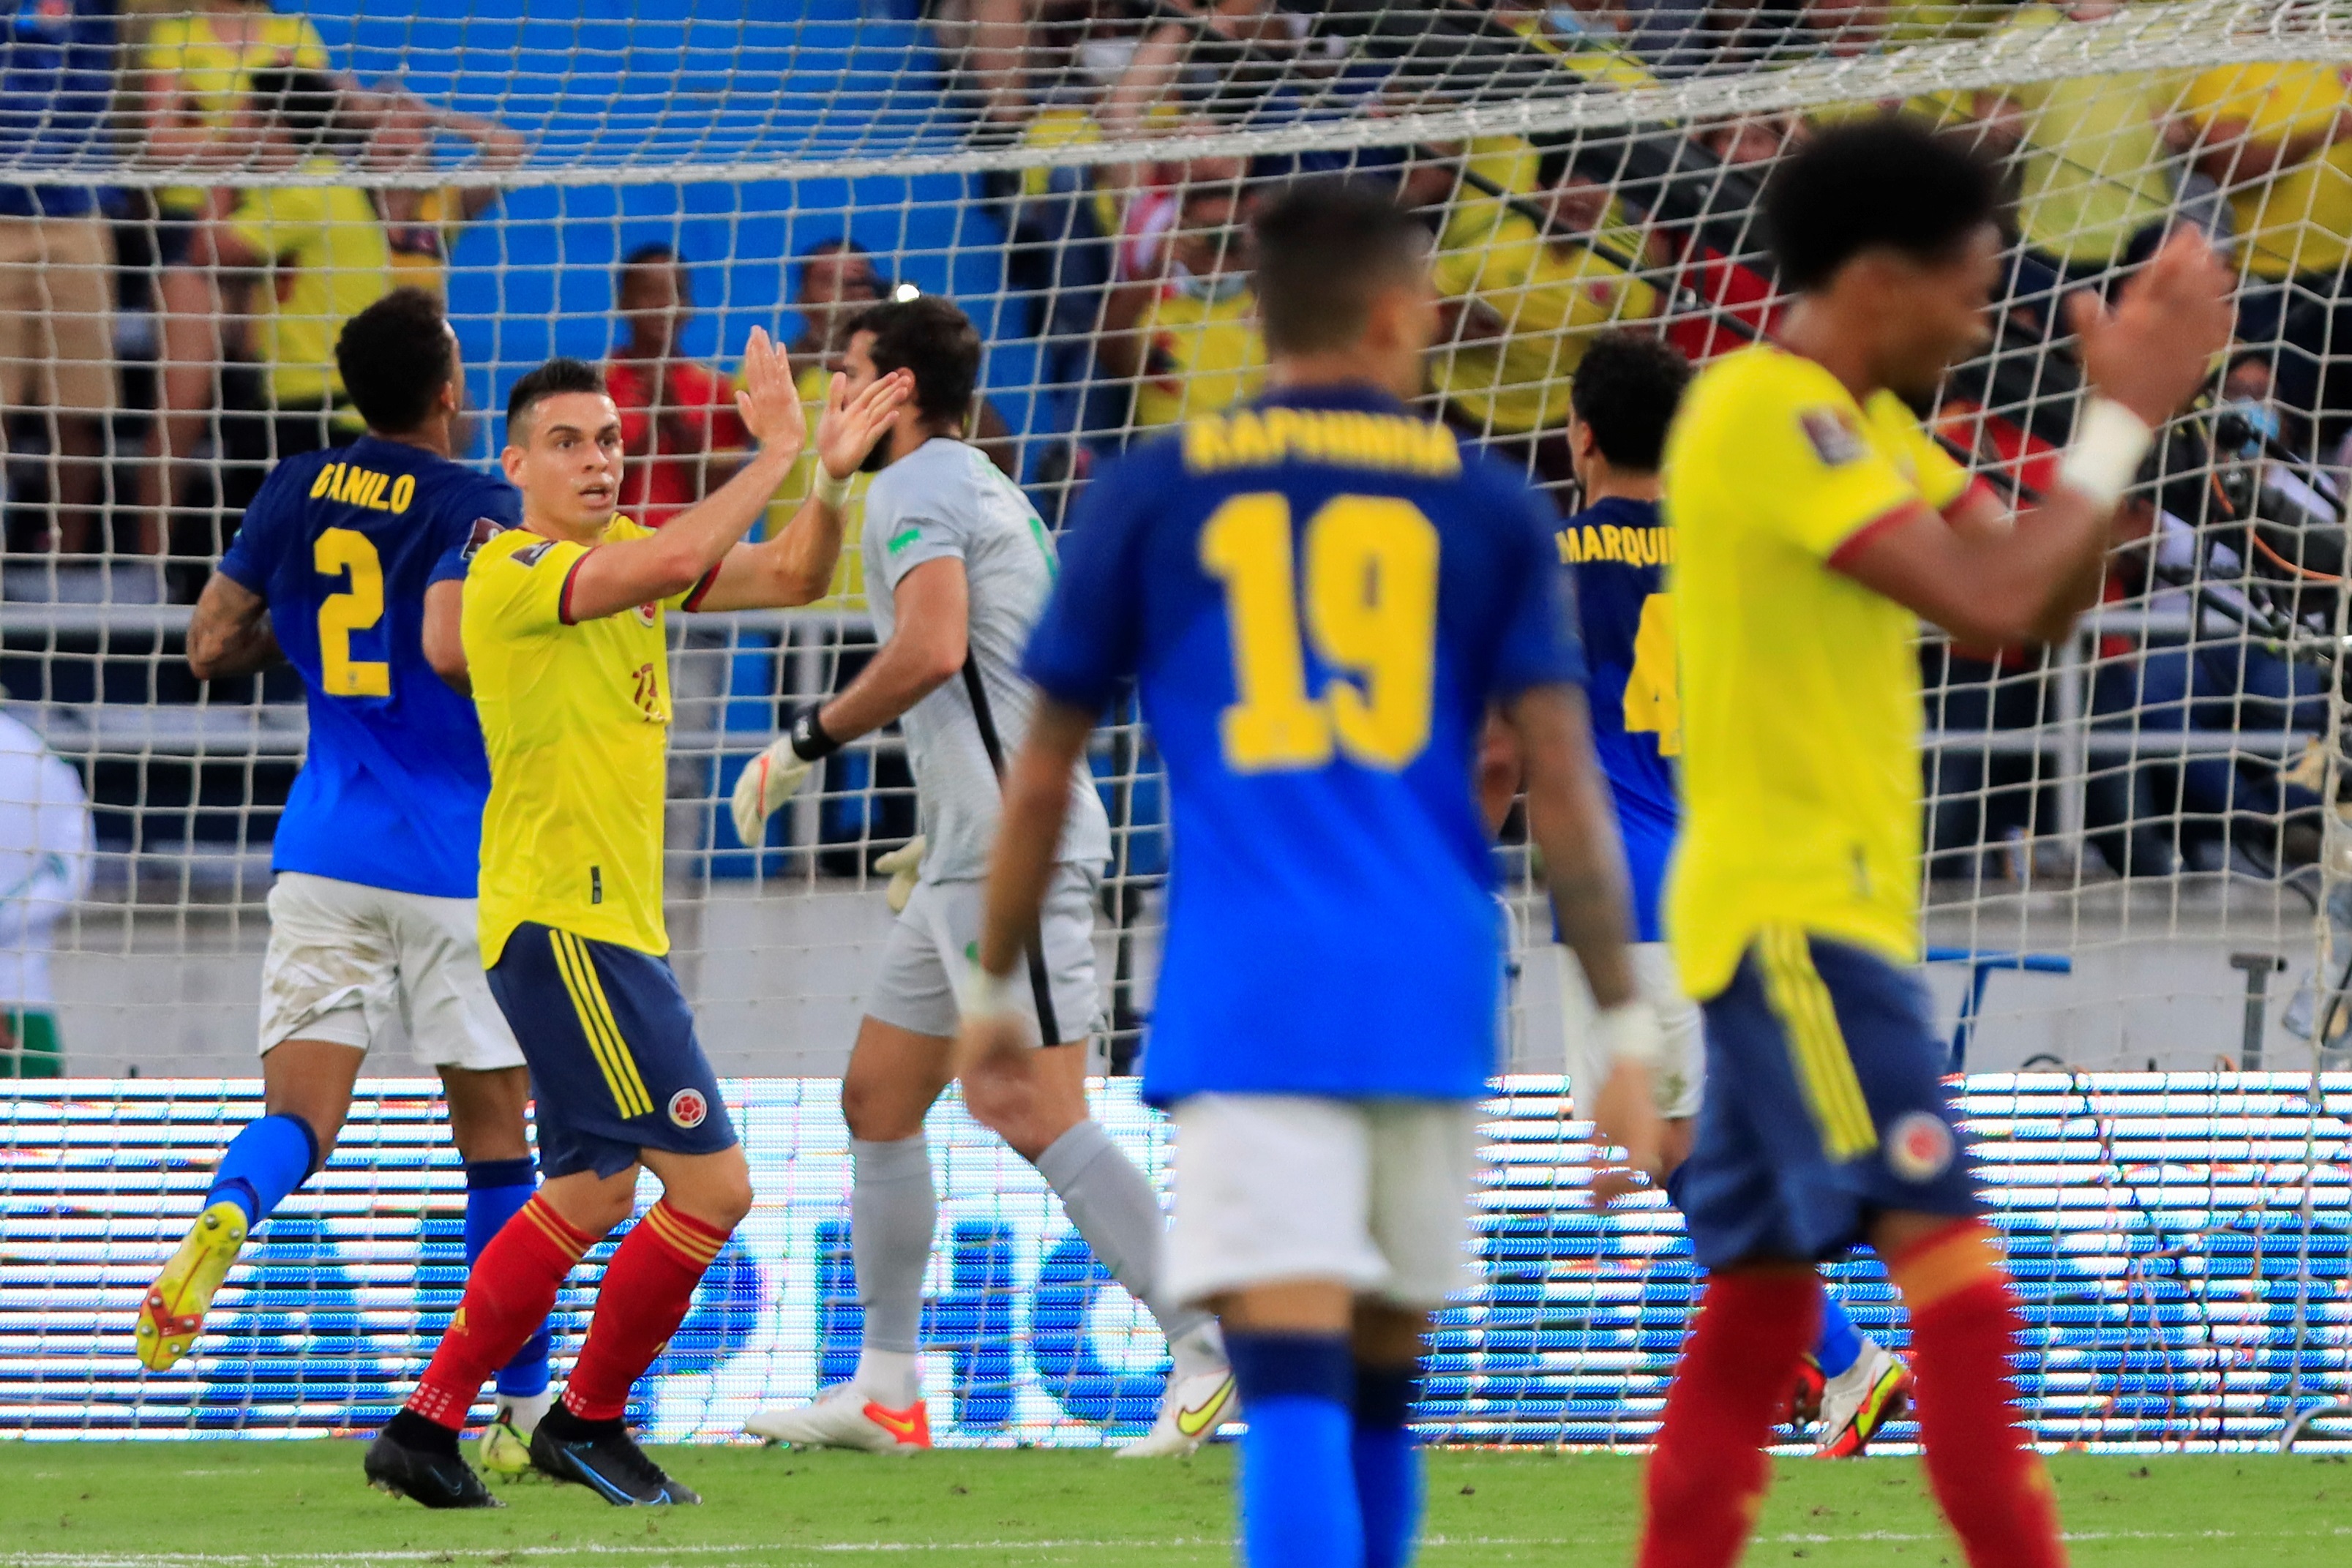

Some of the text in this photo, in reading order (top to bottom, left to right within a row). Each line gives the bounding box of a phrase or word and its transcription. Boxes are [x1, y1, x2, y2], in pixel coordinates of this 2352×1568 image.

[309, 462, 416, 514] DANILO
[313, 527, 391, 697] 2
[1199, 492, 1441, 775] 19
[1622, 592, 1682, 757] 4
